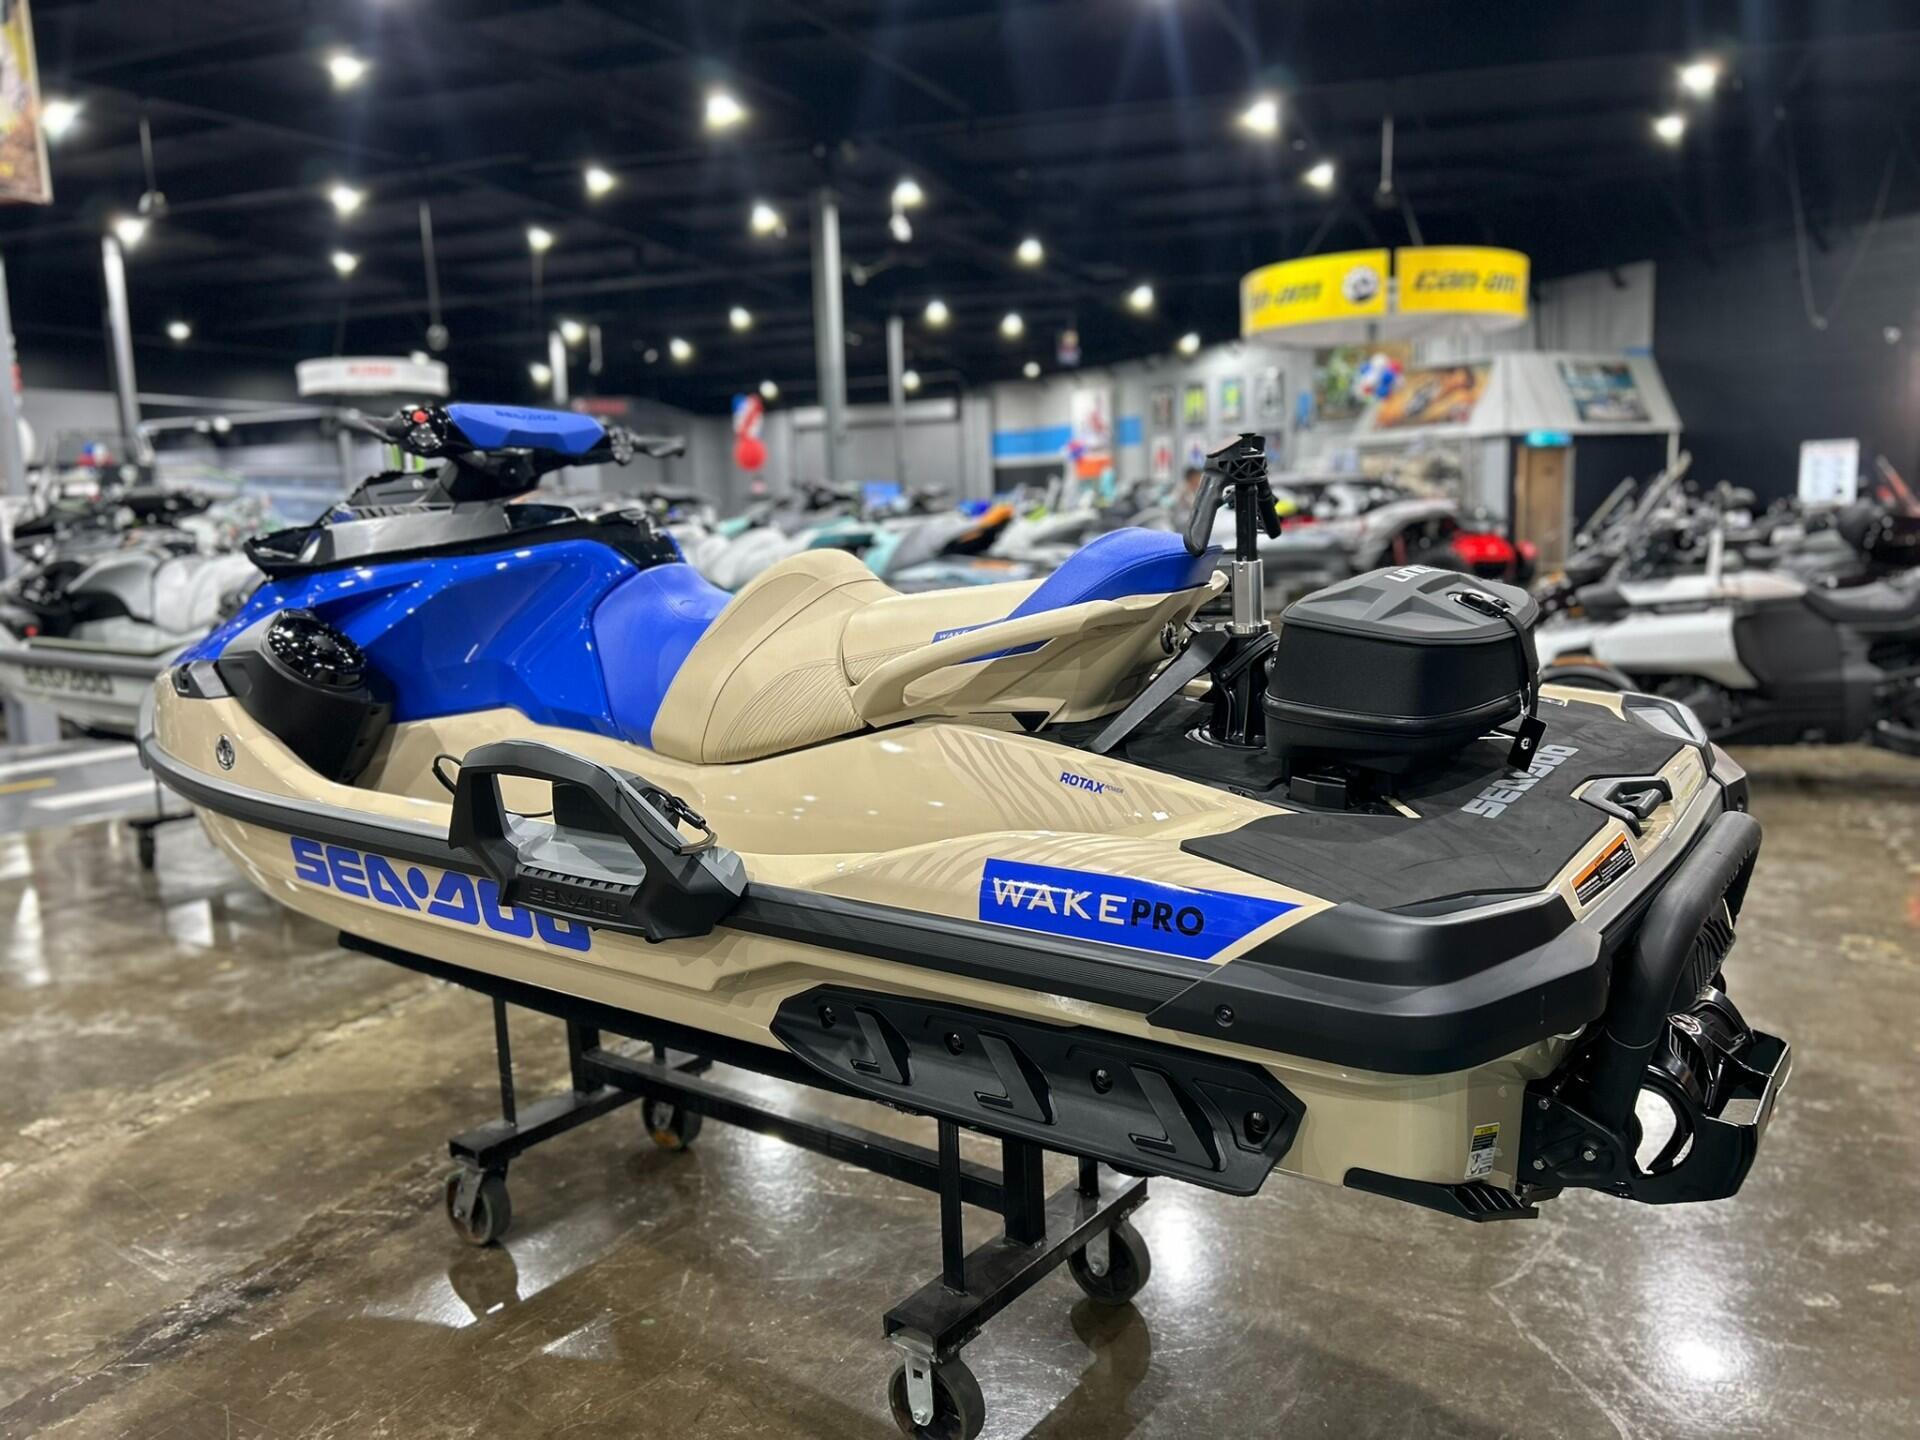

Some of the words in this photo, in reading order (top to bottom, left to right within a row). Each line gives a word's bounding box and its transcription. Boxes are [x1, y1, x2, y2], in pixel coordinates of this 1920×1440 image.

[1059, 771, 1105, 795] ROTAX
[993, 876, 1128, 926] WAKE
[1130, 898, 1205, 937] PRO
